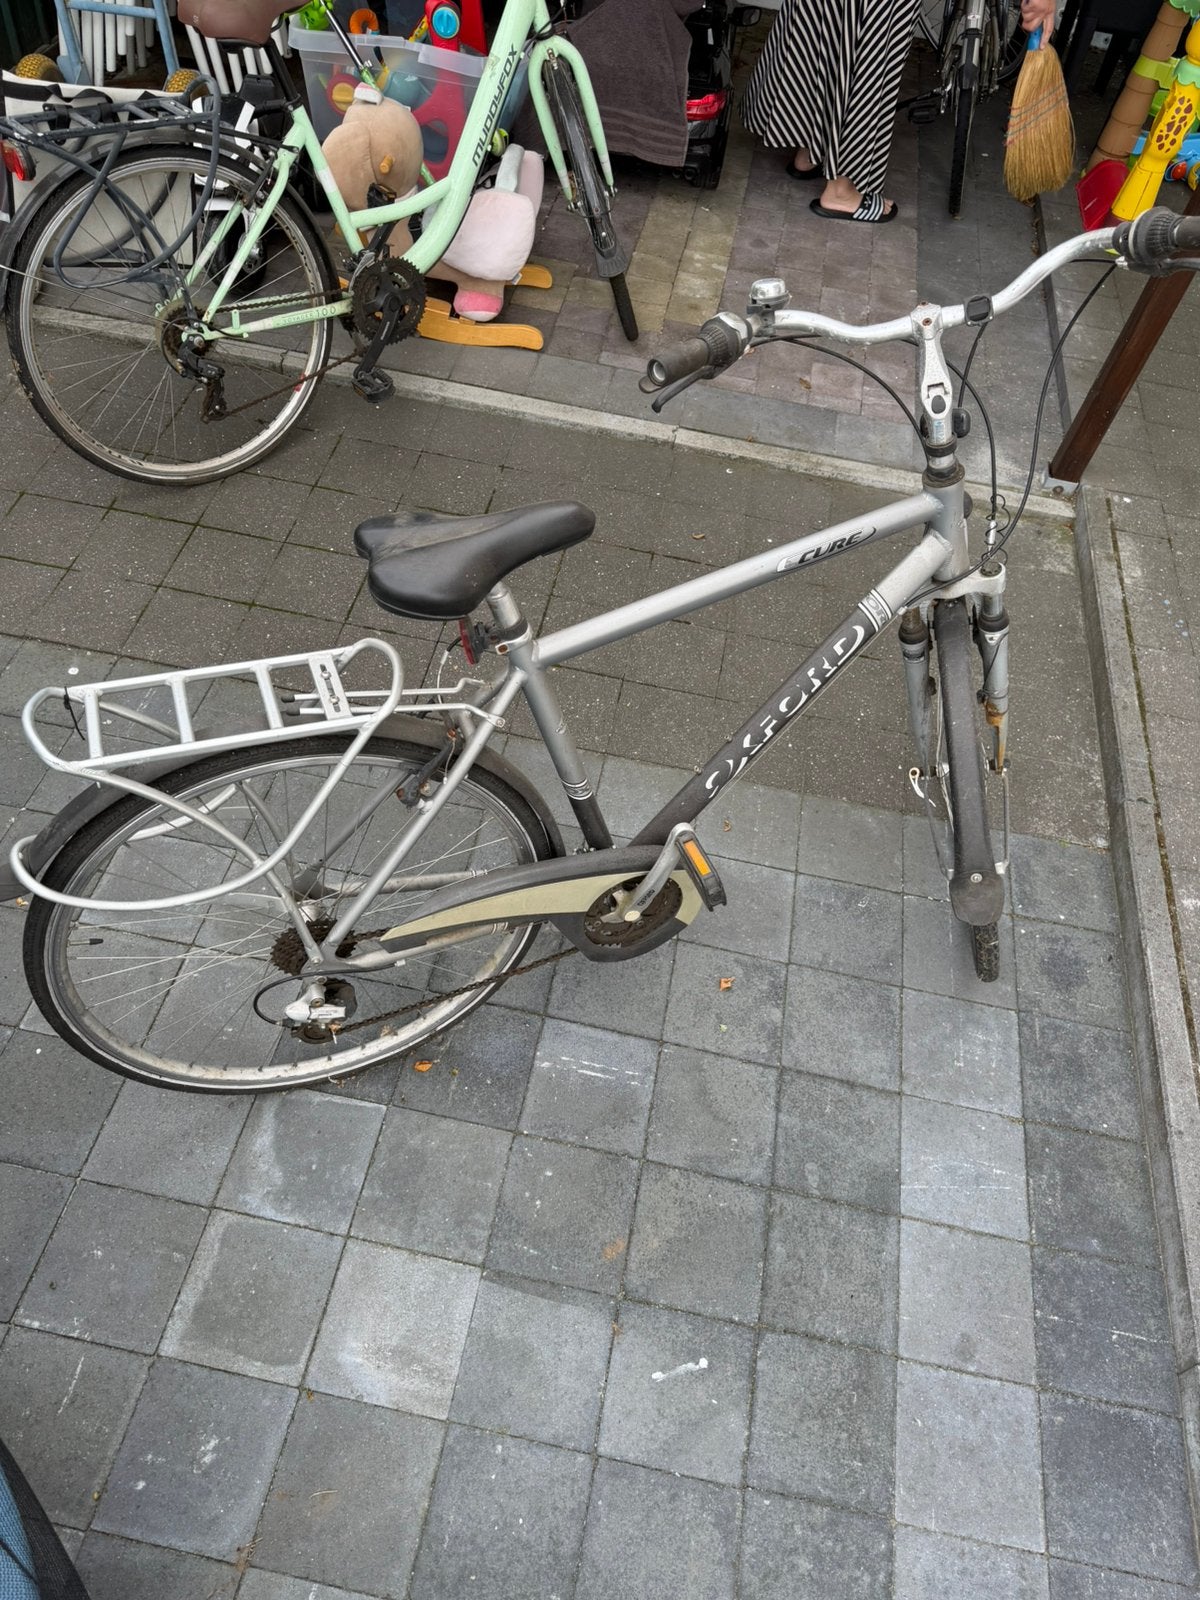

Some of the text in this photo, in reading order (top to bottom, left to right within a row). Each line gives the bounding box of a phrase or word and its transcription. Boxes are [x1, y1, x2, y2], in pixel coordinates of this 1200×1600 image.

[472, 43, 518, 167] MUDDYFOX
[315, 306, 337, 318] 100
[798, 531, 862, 564] CURE
[705, 625, 865, 799] OXFORD
